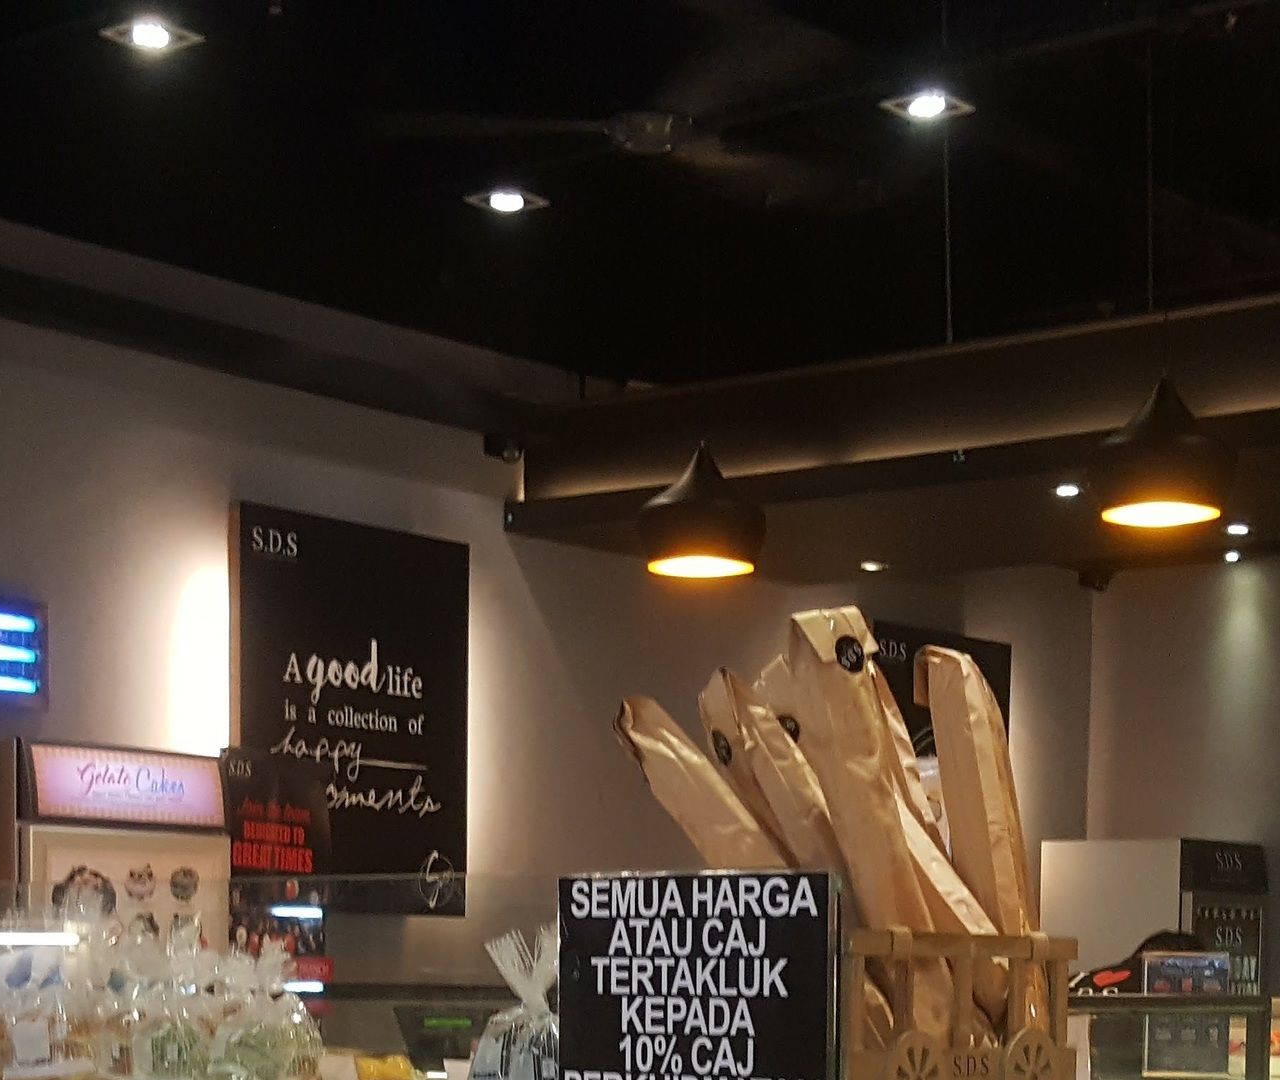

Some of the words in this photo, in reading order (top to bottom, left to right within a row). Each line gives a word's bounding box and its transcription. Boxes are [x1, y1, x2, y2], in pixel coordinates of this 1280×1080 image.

[252, 525, 298, 557] S.D.S
[282, 652, 304, 684] A
[306, 637, 386, 704] good
[387, 664, 423, 699] life
[284, 698, 297, 721] is
[308, 705, 317, 725] a
[327, 705, 398, 733] collection
[408, 713, 425, 736] of
[271, 725, 362, 783] happy
[76, 761, 132, 796] Gelato
[136, 767, 185, 797] Cakes
[325, 774, 442, 818] oments
[570, 879, 685, 918] SEMUA
[692, 876, 818, 918] HARGA
[608, 918, 692, 957] ATAU
[702, 917, 766, 957] CAJ
[591, 956, 788, 998] TERTAKLUK
[621, 996, 755, 1037] KEPADA
[619, 1034, 683, 1075] 10%
[691, 1036, 754, 1077] CAJ
